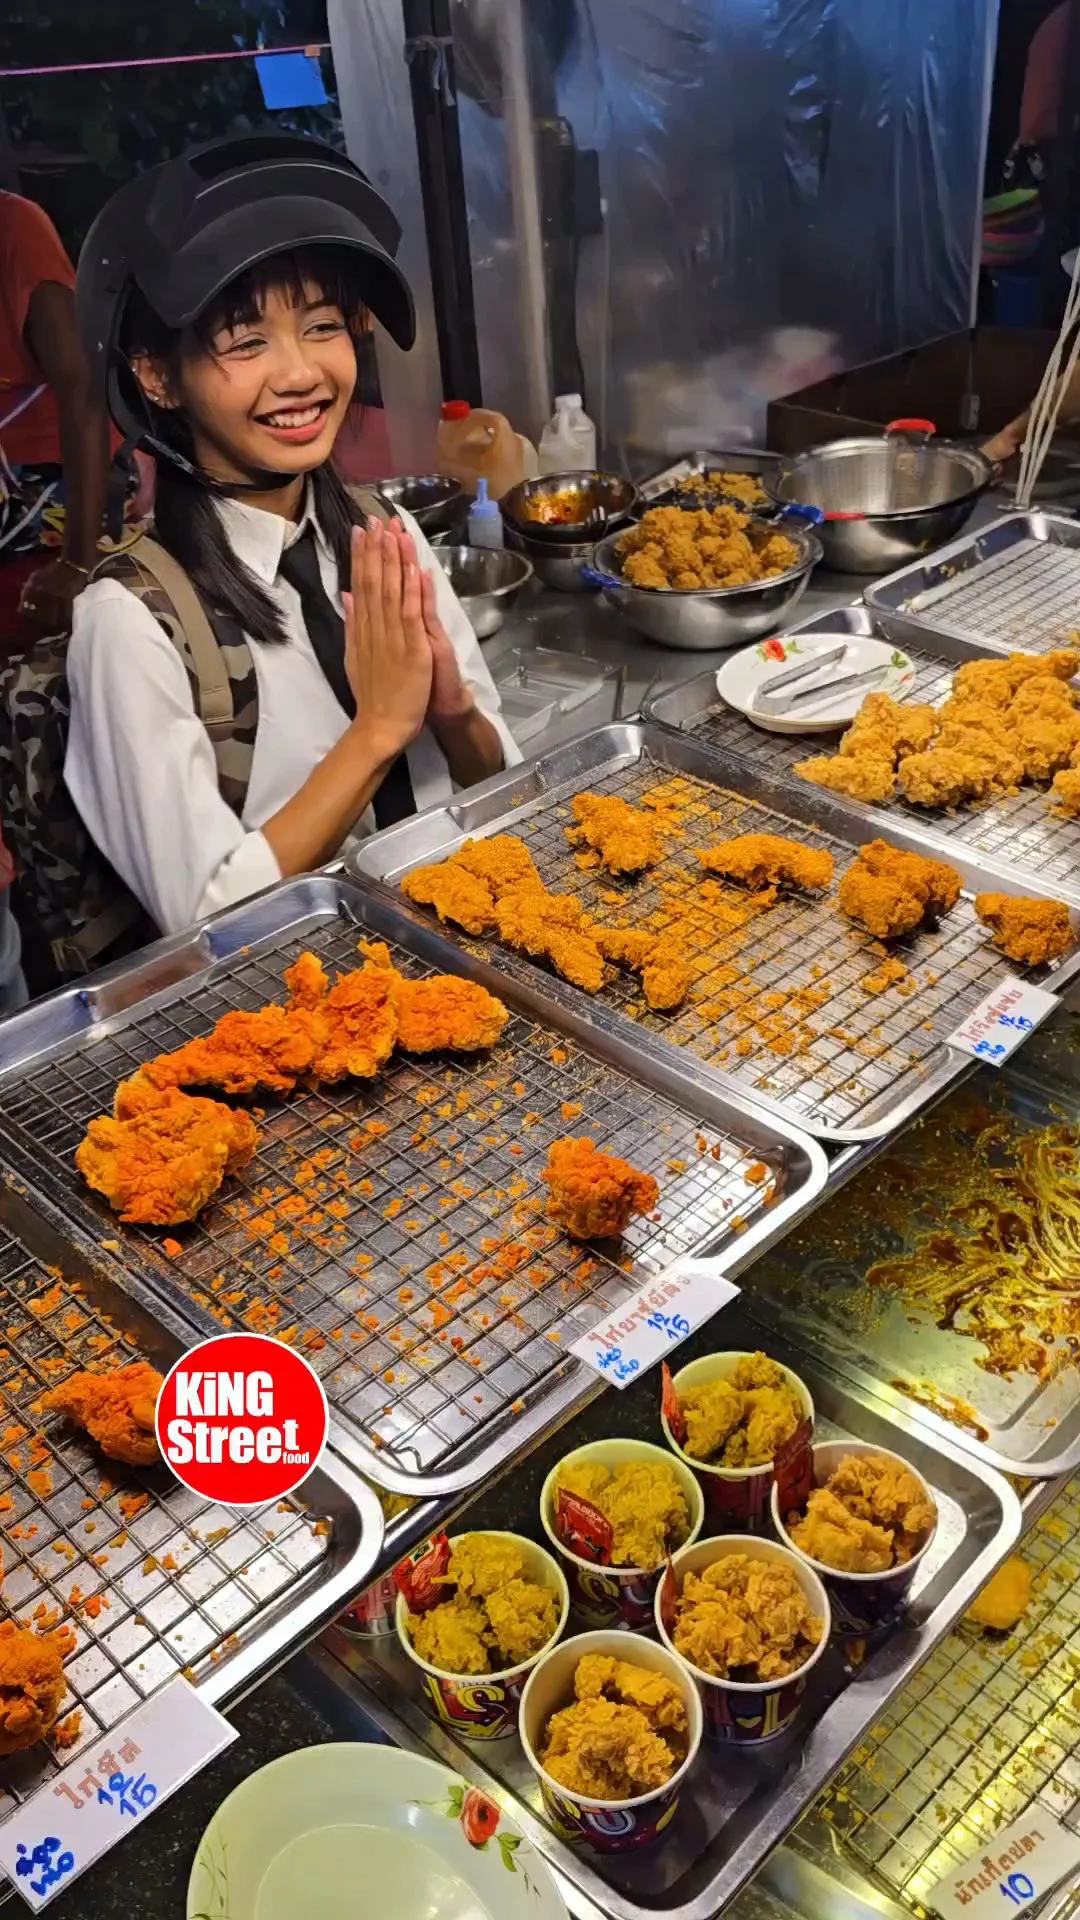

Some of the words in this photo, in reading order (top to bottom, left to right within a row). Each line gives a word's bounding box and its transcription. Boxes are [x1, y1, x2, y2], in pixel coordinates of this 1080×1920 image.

[647, 1312, 670, 1331] 12
[667, 1314, 690, 1340] 15
[97, 1771, 134, 1806] 12
[120, 1772, 157, 1817] 15
[999, 1872, 1034, 1905] 10
